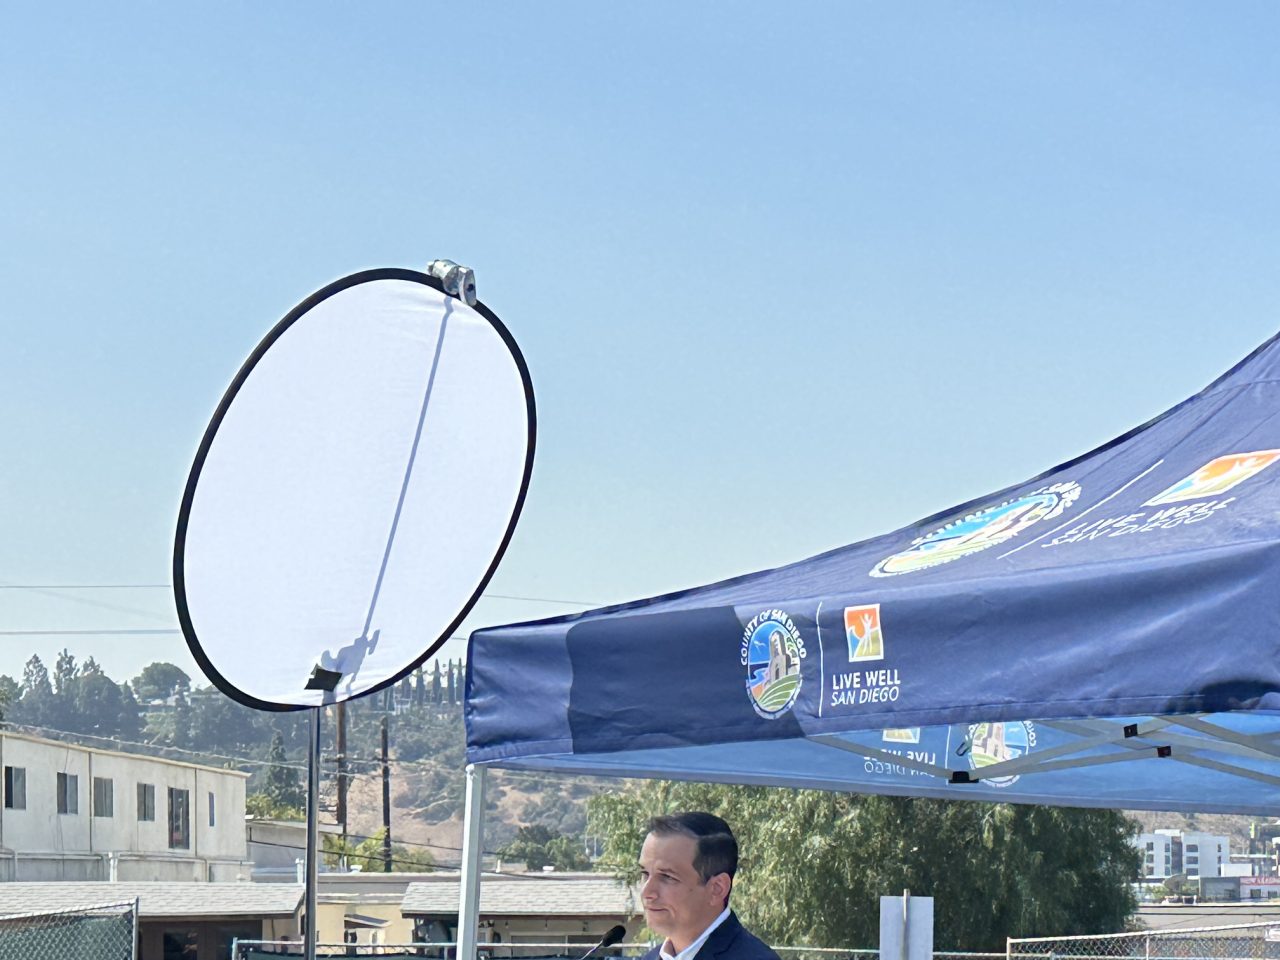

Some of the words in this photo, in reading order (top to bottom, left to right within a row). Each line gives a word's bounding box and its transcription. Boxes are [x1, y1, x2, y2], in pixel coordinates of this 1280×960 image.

[740, 616, 759, 666] COUNTY
[759, 609, 772, 622] OF
[771, 609, 789, 625] SAN
[785, 618, 807, 659] DIEGO
[832, 672, 861, 690] LIVE
[866, 669, 901, 687] WELL
[831, 690, 856, 706] SAN
[859, 686, 900, 705] DIEGO
